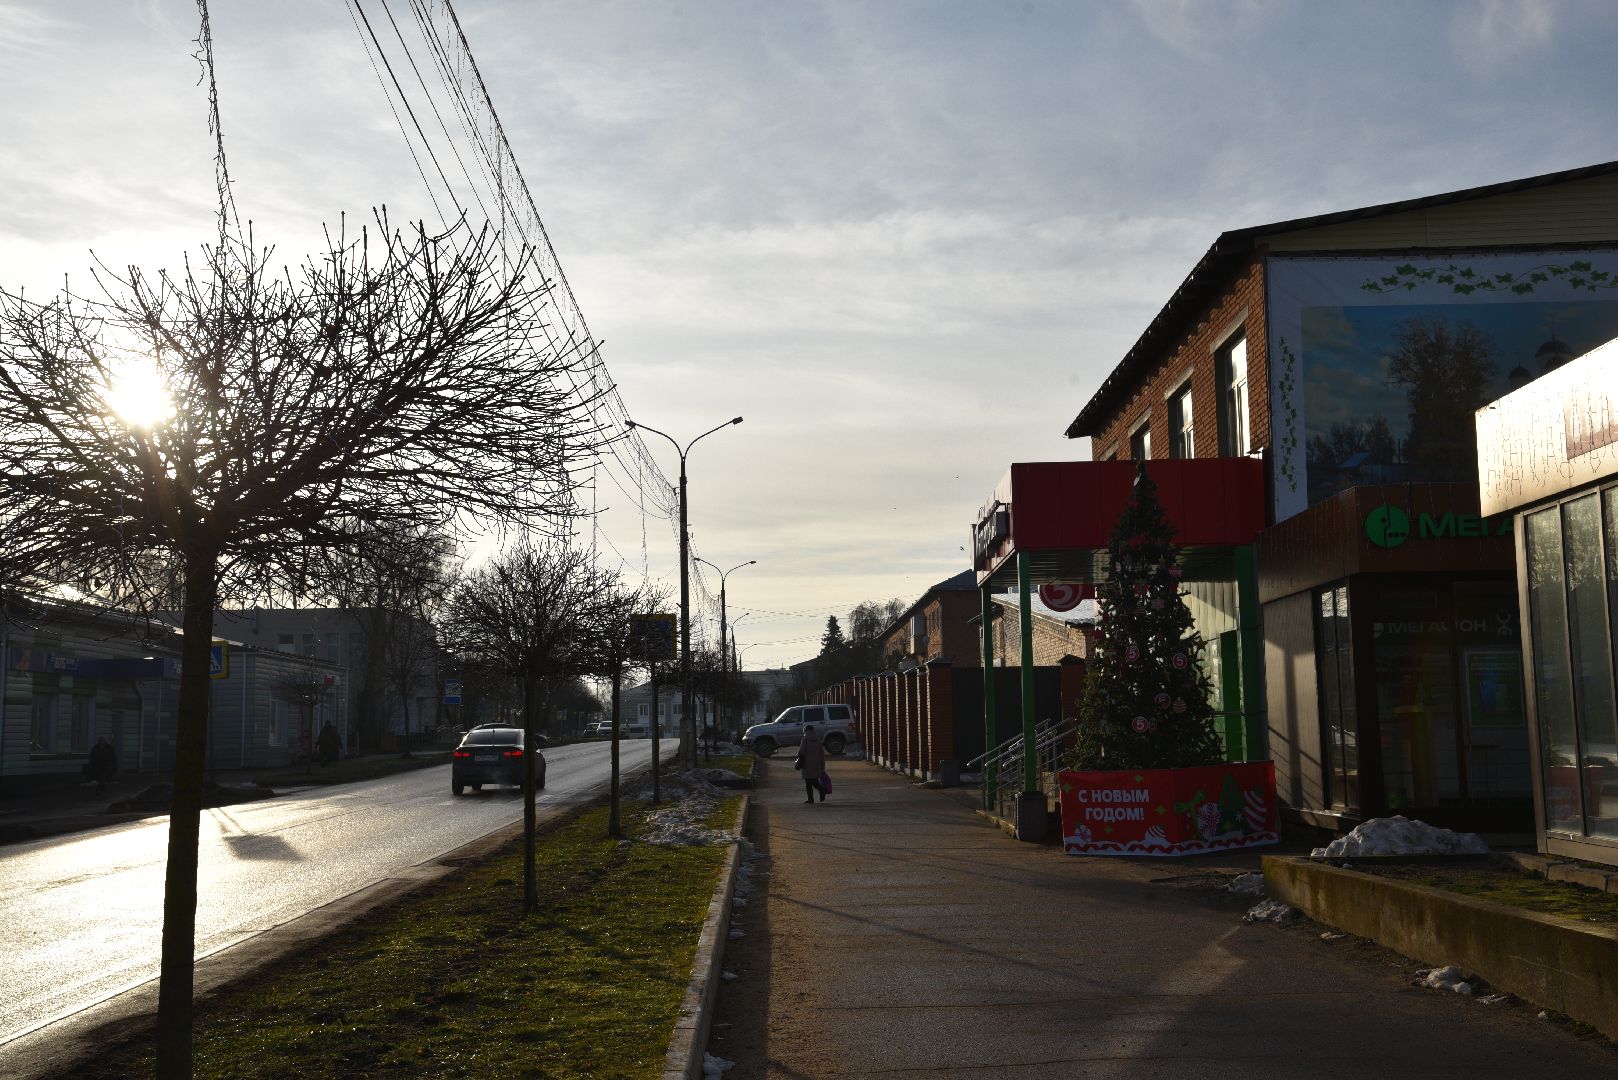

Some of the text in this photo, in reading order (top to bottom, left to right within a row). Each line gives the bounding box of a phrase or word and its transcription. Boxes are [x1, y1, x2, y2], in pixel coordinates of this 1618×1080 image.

[1079, 789, 1149, 803] С НОВЫМ
[1085, 808, 1144, 822] ГОДОМ!
